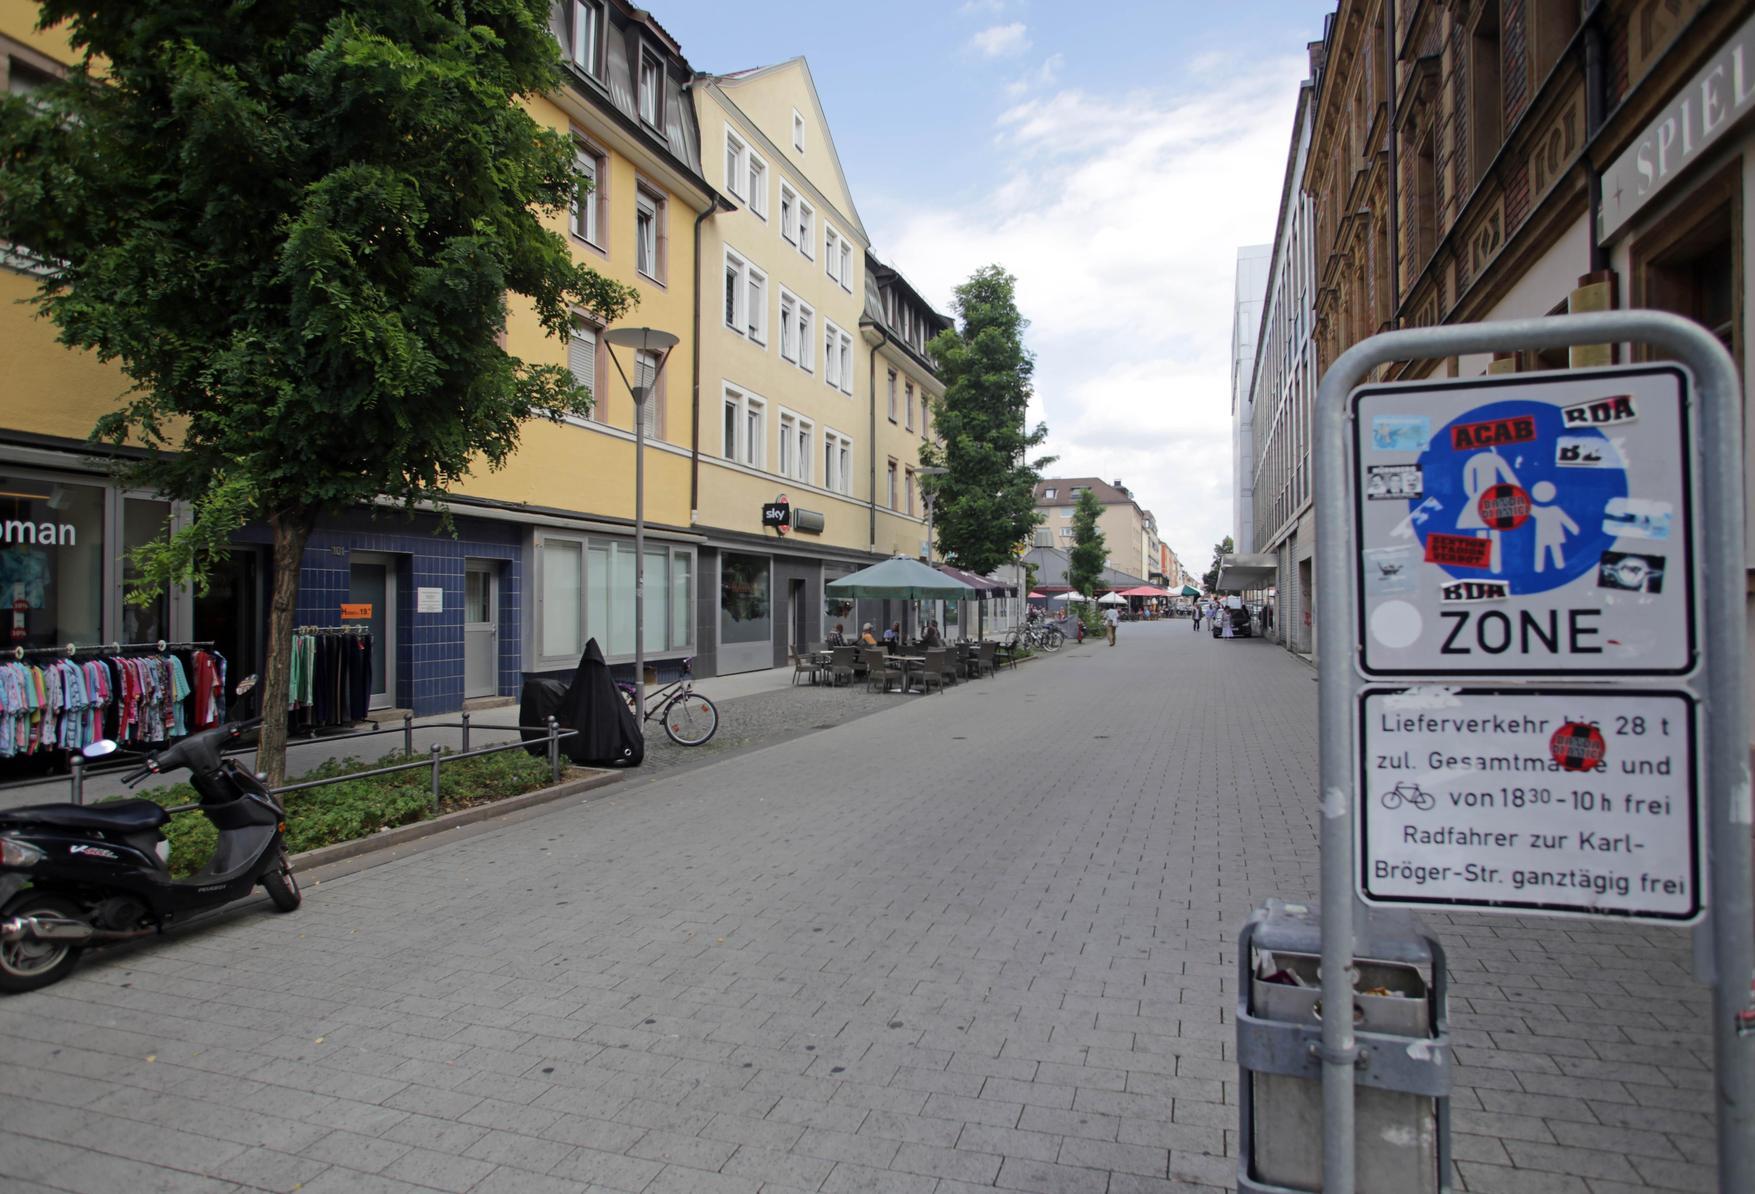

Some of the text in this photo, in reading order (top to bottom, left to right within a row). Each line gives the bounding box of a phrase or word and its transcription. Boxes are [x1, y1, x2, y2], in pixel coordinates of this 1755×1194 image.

[1455, 420, 1534, 448] ACAB
[766, 507, 785, 520] sky
[0, 519, 76, 546] man
[1443, 582, 1506, 600] BDA
[1440, 609, 1603, 655] ZONE
[1381, 714, 1549, 733] Lieferverkehr
[1616, 716, 1645, 736] 28
[1661, 717, 1670, 736] t
[1376, 751, 1671, 775] zul. Gesamtmae und
[1450, 792, 1494, 807] von
[1625, 793, 1671, 815] frei
[1404, 825, 1645, 853] Radfahrer zur Karl-
[1375, 860, 1686, 896] Bröger-Str. ganztägig frei
